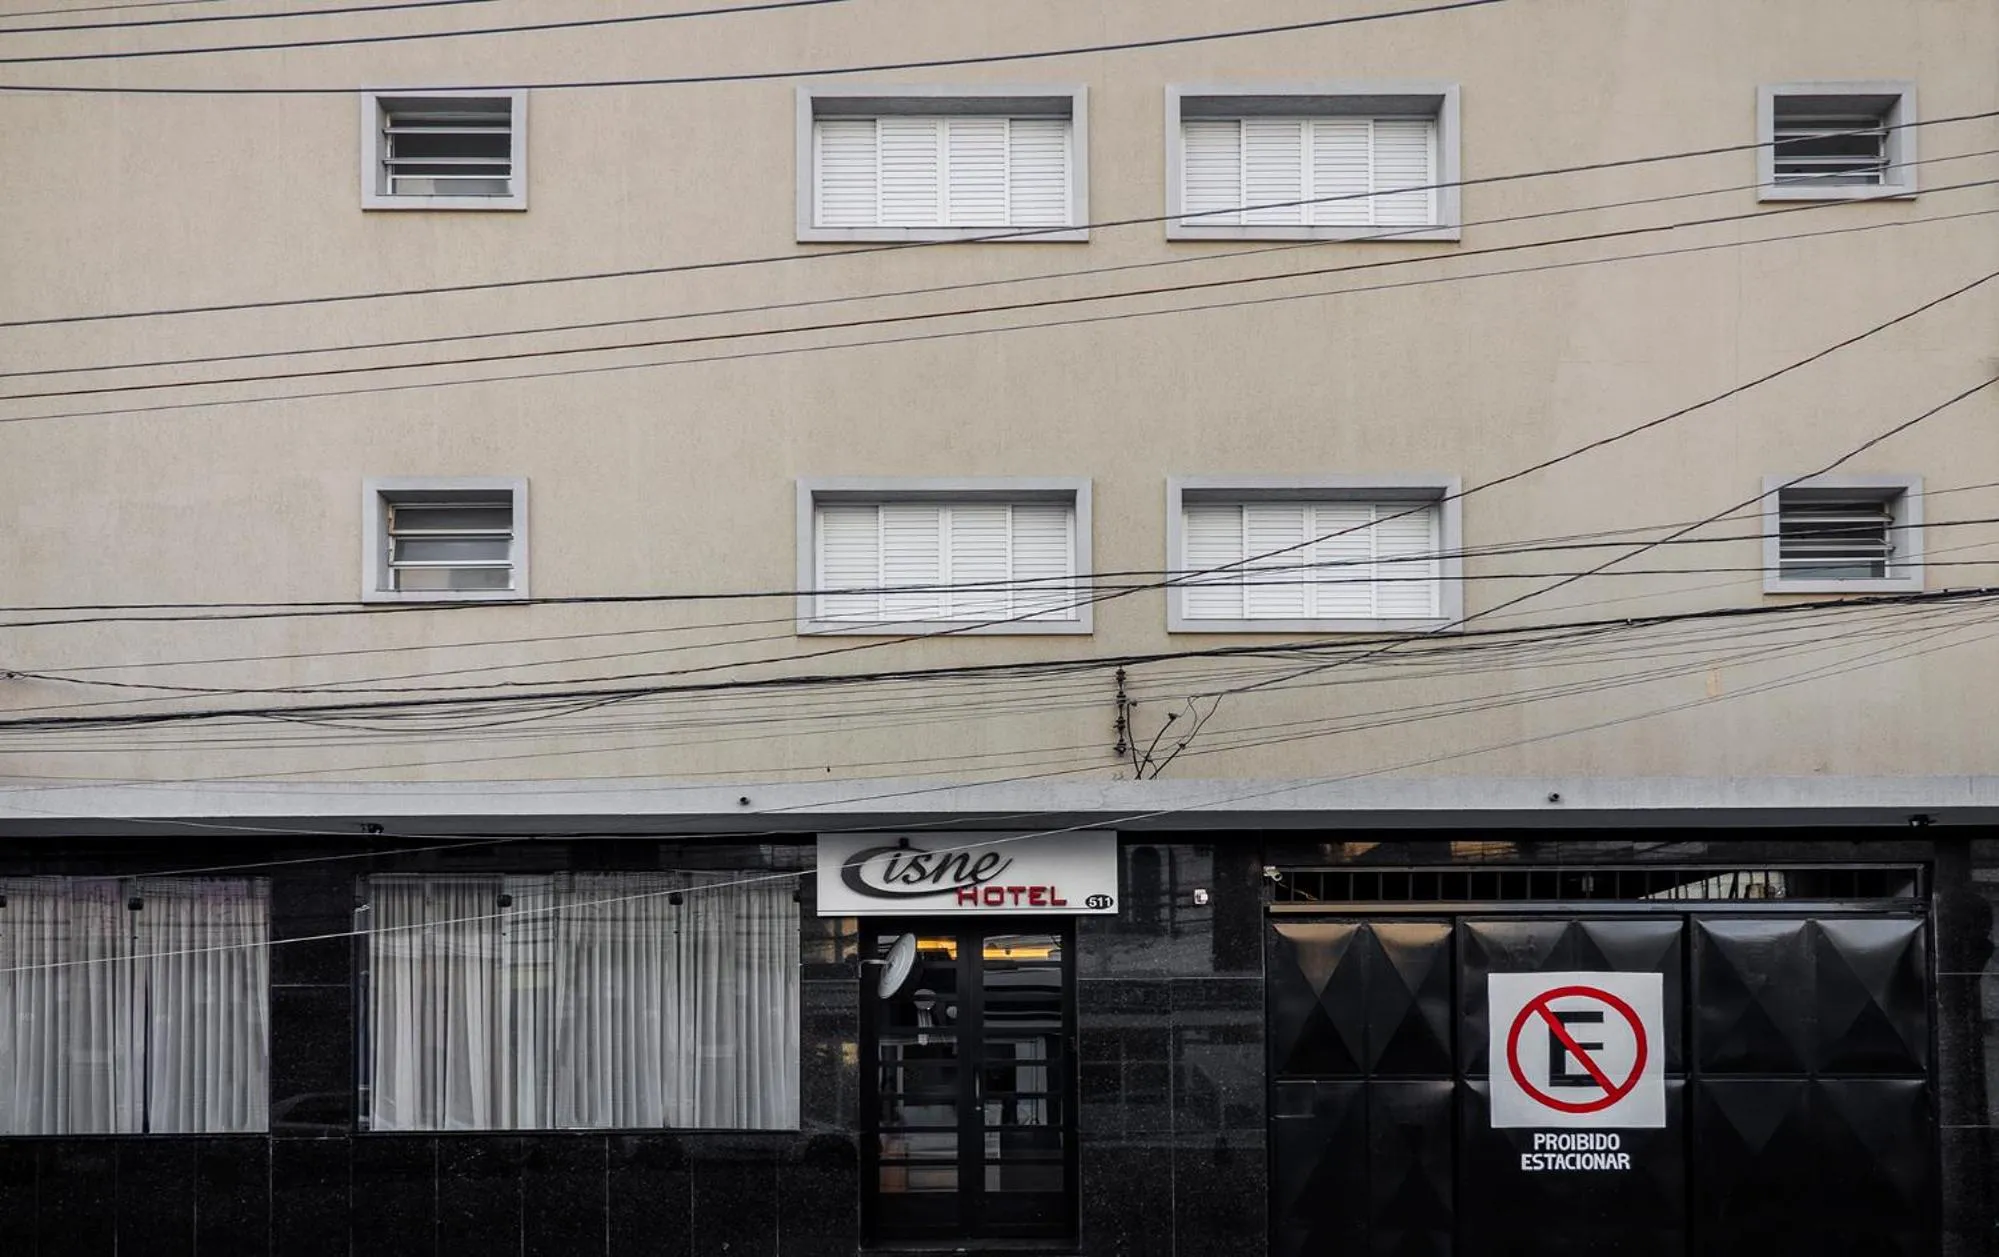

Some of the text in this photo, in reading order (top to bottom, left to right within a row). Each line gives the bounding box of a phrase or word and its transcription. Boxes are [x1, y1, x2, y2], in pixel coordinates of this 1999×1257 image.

[841, 838, 1013, 898] Cisne
[955, 886, 1067, 906] HOTEL
[1089, 895, 1113, 909] 511
[1549, 1011, 1604, 1087] E
[1534, 1133, 1620, 1150] PROIBIDO
[1521, 1153, 1631, 1170] ESTACIONAR
